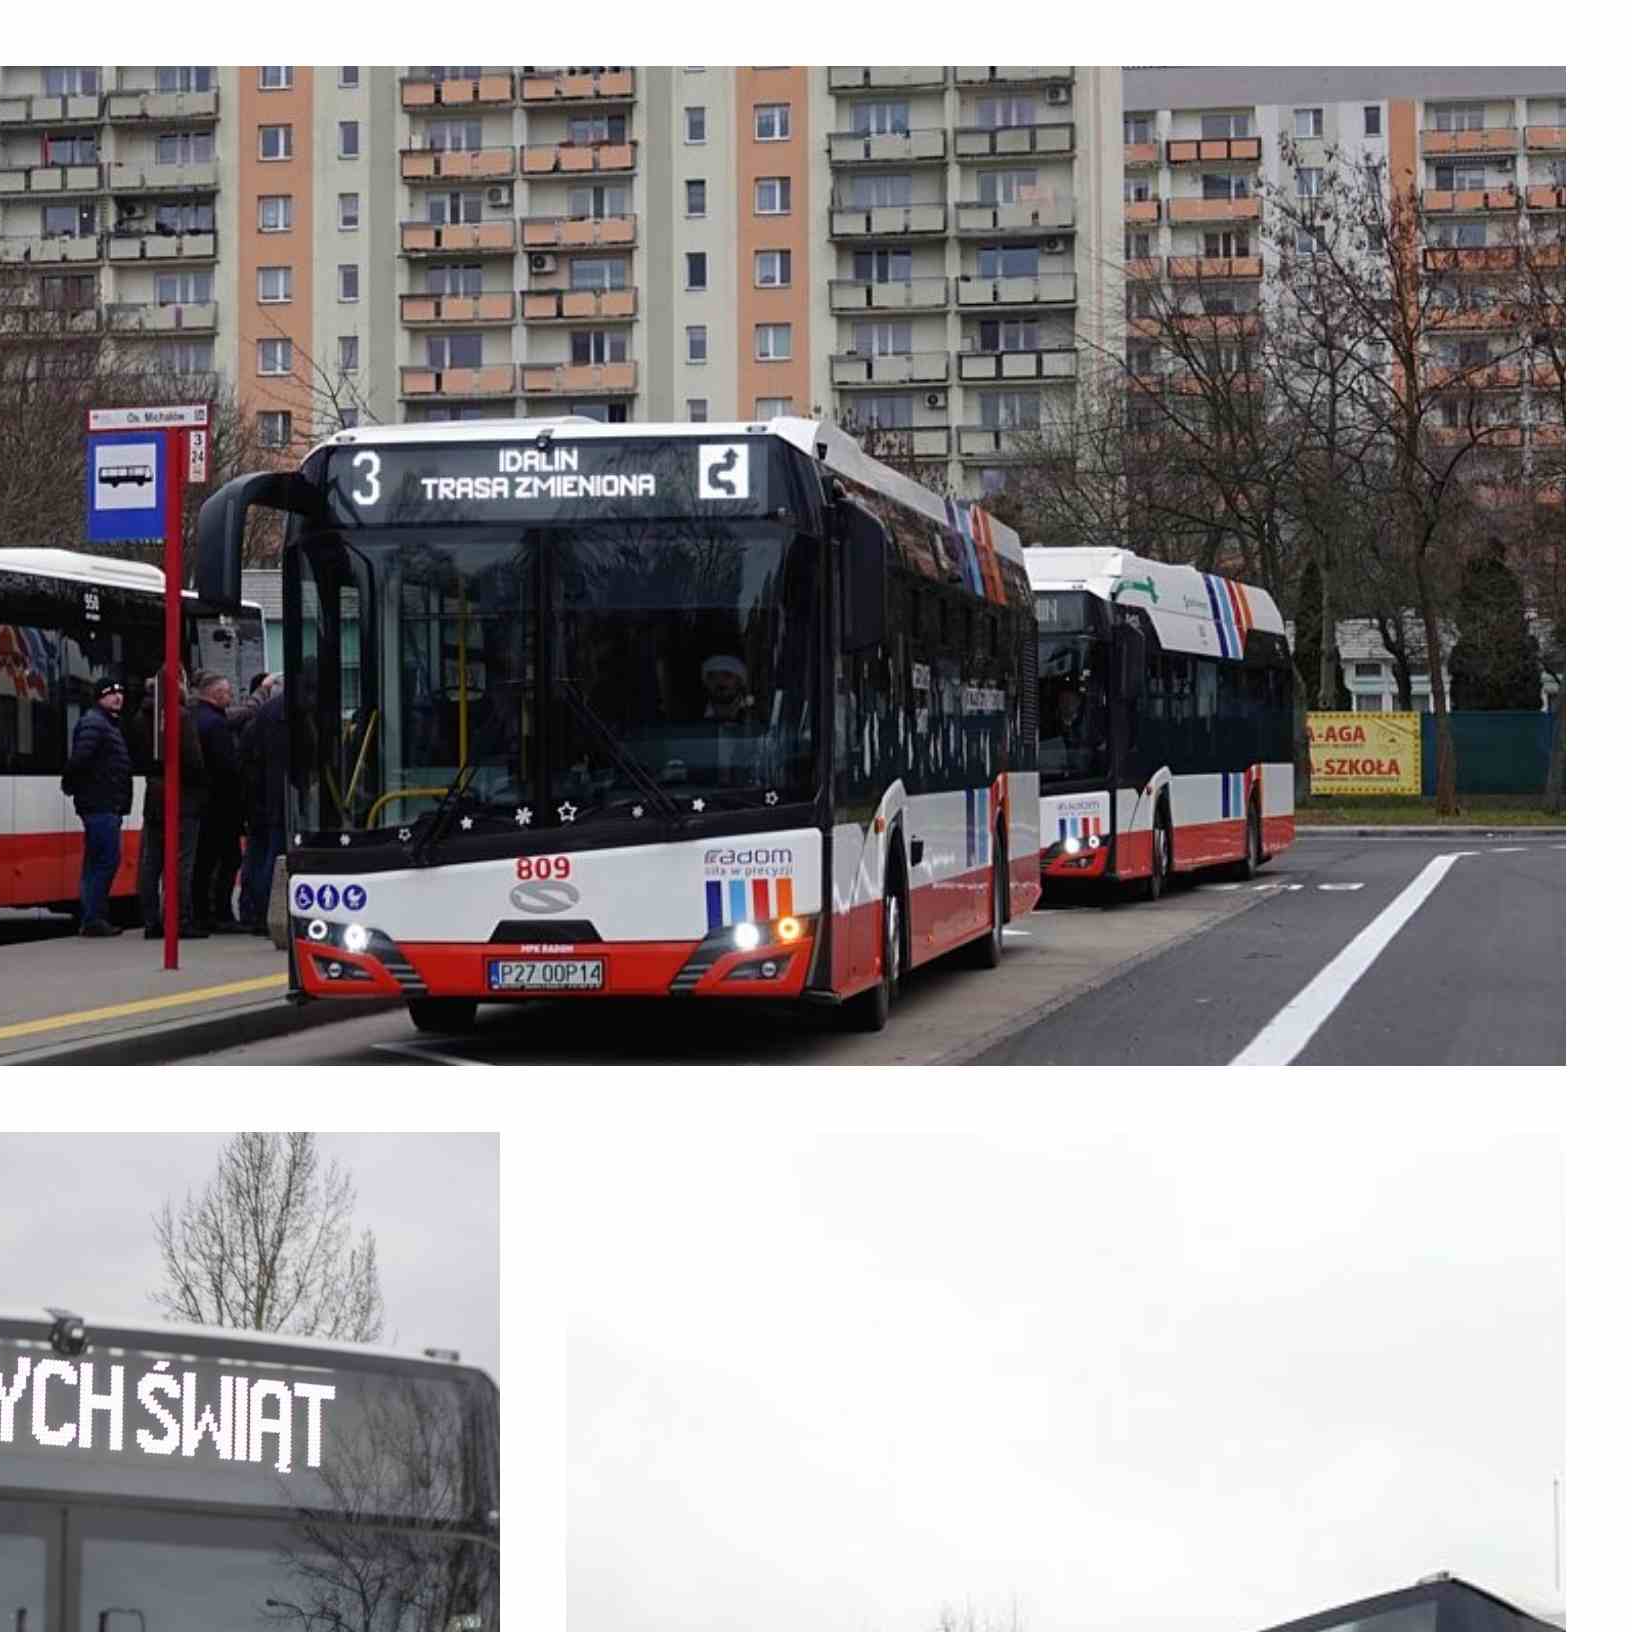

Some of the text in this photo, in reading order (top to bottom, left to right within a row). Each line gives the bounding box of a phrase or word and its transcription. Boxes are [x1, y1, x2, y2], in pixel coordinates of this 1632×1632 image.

[196, 433, 203, 446] 3
[191, 450, 204, 463] 24
[498, 448, 579, 473] IDALIN
[352, 450, 381, 505] 3
[420, 473, 656, 500] TRASA ZMIENIONA
[516, 855, 571, 880] 809
[704, 848, 793, 865] radom
[501, 963, 537, 983] P27
[135, 1360, 337, 1474] ŚWIĄT
